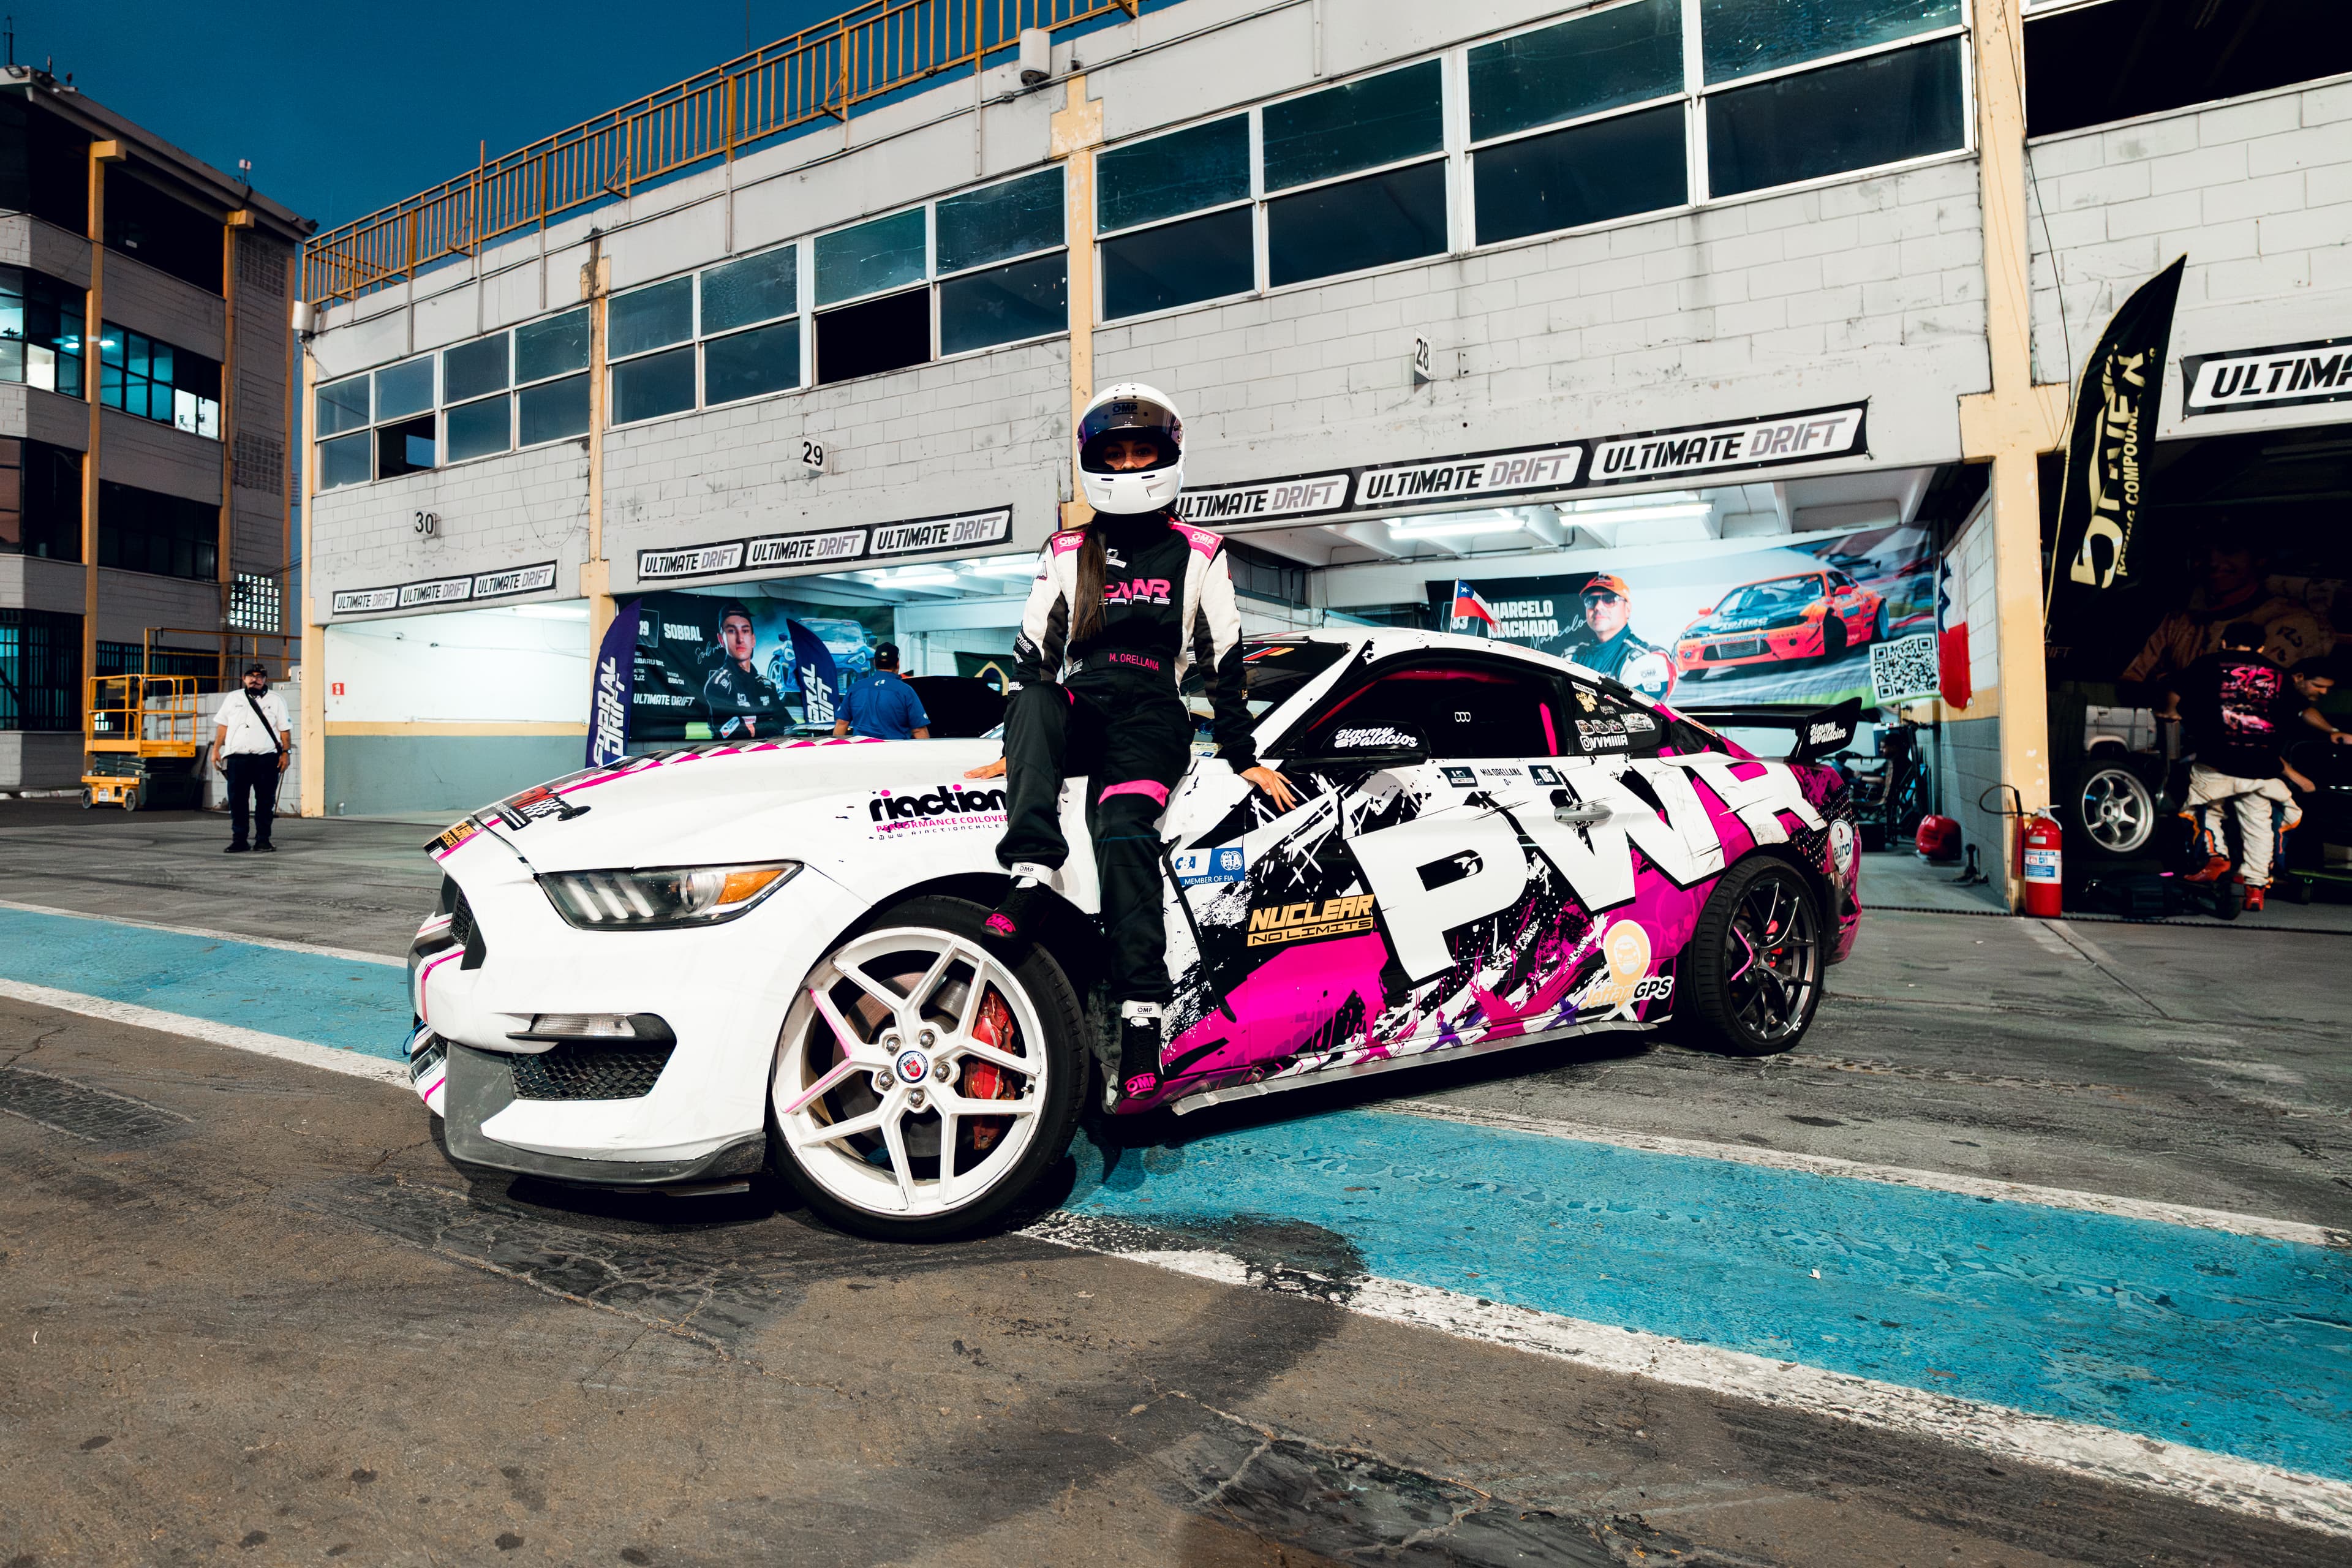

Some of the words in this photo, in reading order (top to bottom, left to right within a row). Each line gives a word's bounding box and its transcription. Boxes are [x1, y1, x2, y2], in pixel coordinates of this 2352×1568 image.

[1416, 337, 1429, 371] 28
[1113, 404, 1137, 413] OMP
[802, 440, 824, 467] 29
[1272, 481, 1340, 511] DRIFT
[1366, 464, 1485, 500] ULTIMATE
[1488, 453, 1570, 486] DRIFT
[1603, 431, 1745, 474] ULTIMATE
[1749, 417, 1847, 457] DRIFT
[415, 511, 435, 535] 30
[644, 552, 699, 573] ULTIMATE
[701, 548, 738, 569] DRIFT
[752, 539, 816, 562] ULTIMATE
[816, 534, 861, 556] DRIFT
[876, 523, 951, 550] ULTIMATE
[952, 516, 1003, 542] DRIFT
[1059, 535, 1082, 546] OMP
[1191, 533, 1215, 546] OMP
[337, 594, 372, 609] ULTIMATE
[372, 592, 396, 608] DRIFT
[404, 584, 442, 603] ULTIMATE
[442, 582, 469, 600] DRIFT
[478, 573, 521, 594] ULTIMATE
[522, 568, 551, 587] DRIFT
[1487, 600, 1553, 619] MARCELO
[663, 622, 703, 642] SOBRAL
[1487, 619, 1559, 639] MACHADO
[1109, 653, 1118, 662] M.
[1120, 653, 1159, 671] ORELLANA
[633, 693, 670, 706] ULTIMATE
[671, 696, 695, 707] DRIFT
[816, 677, 835, 723] RIFT
[593, 657, 616, 767] SOBRAL
[604, 673, 625, 757] DRIFT
[1335, 727, 1395, 740] Jimmy
[1349, 733, 1419, 748] Palacios
[1493, 767, 1523, 776] ORELLANA
[1537, 768, 1556, 783] 06
[869, 783, 1007, 822] riaction
[876, 818, 957, 833] PERFORMANCE
[1833, 837, 1852, 860] eurol
[1019, 865, 1034, 874] OMP
[1175, 855, 1196, 870] CBA
[1221, 852, 1243, 869] FIA
[1184, 876, 1213, 885] MEMBER
[1346, 760, 1828, 982] PWR
[1248, 894, 1375, 932] NUCLEAR
[1252, 932, 1283, 945] NO
[1286, 919, 1371, 940] LIMITS
[1126, 1076, 1156, 1093] OMP
